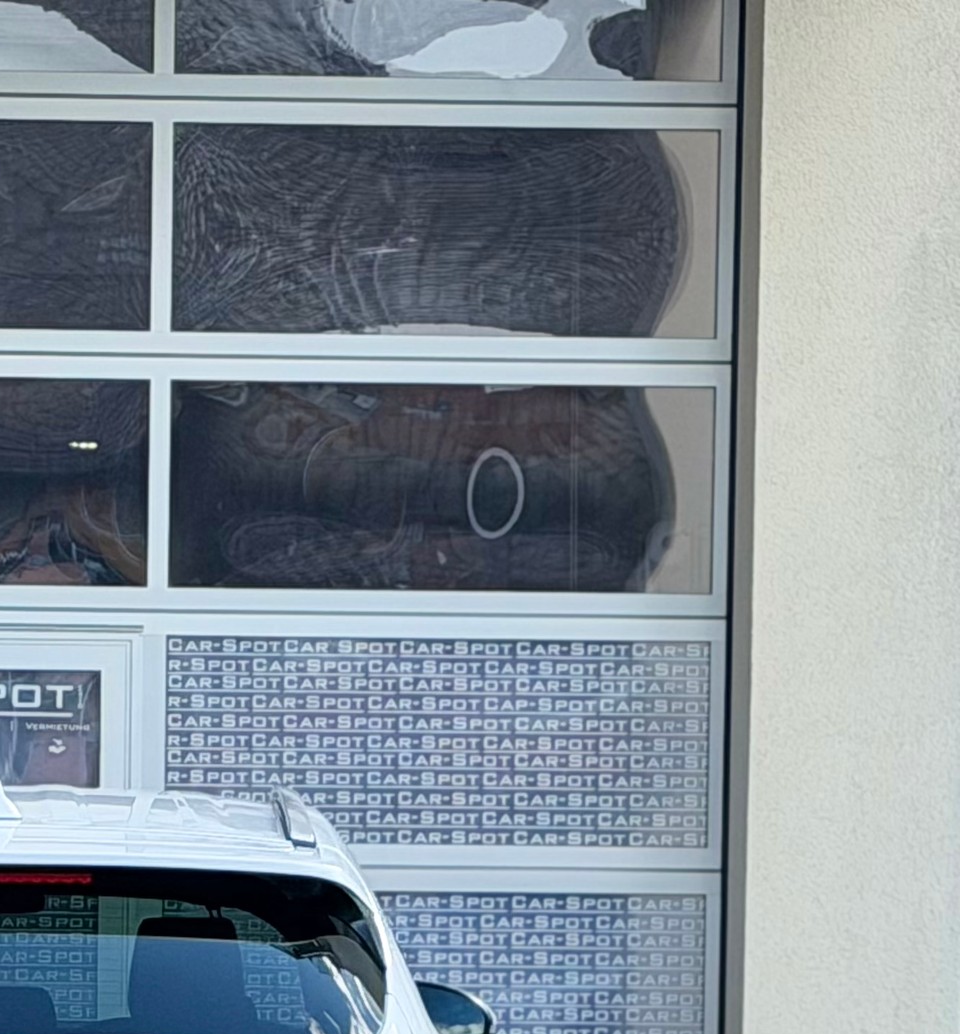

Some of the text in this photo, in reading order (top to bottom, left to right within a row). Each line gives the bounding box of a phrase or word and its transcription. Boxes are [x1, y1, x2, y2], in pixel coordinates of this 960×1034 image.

[168, 637, 629, 656] CAR-SPOT CAR-SPOT CAR-SPOT
[251, 657, 365, 673] CAR-SPOT
[367, 659, 481, 674] CAR-SPOT
[483, 660, 597, 676] CAR-SPOT
[167, 674, 629, 693] CAR-SPOT CAR-SPOT CAR-SPOT CAR-SPOT
[251, 694, 365, 709] CAR-SPOT
[367, 695, 481, 711] CAR-SPOT
[167, 712, 628, 732] CAR-SPOT CAR-SPOT CAR-SPOT CAR-SPOT
[251, 732, 364, 748] CAR-SPOT
[366, 734, 480, 750] CAR-SPOT
[482, 735, 596, 751] CAR-SPOT
[167, 750, 628, 769] CAR-SPOT CAR-SPOT CAR-SPOT CAR-SPOT
[250, 769, 364, 785] CAR-SPOT
[366, 770, 480, 786] CAR-SPOT
[481, 772, 595, 787] CAR-SPOT
[398, 791, 627, 808] CAR-SPOT CAR-SPOT
[365, 809, 595, 827] CAR-SPOT CAR-SPOT
[397, 830, 626, 846] CAR-SPOT CAR-SPOT
[510, 895, 624, 910] CAR-SPOT
[510, 932, 624, 947] CAR-SPOT
[509, 970, 623, 986] CAR-SPOT
[509, 1007, 623, 1022] CAR-SPOT
